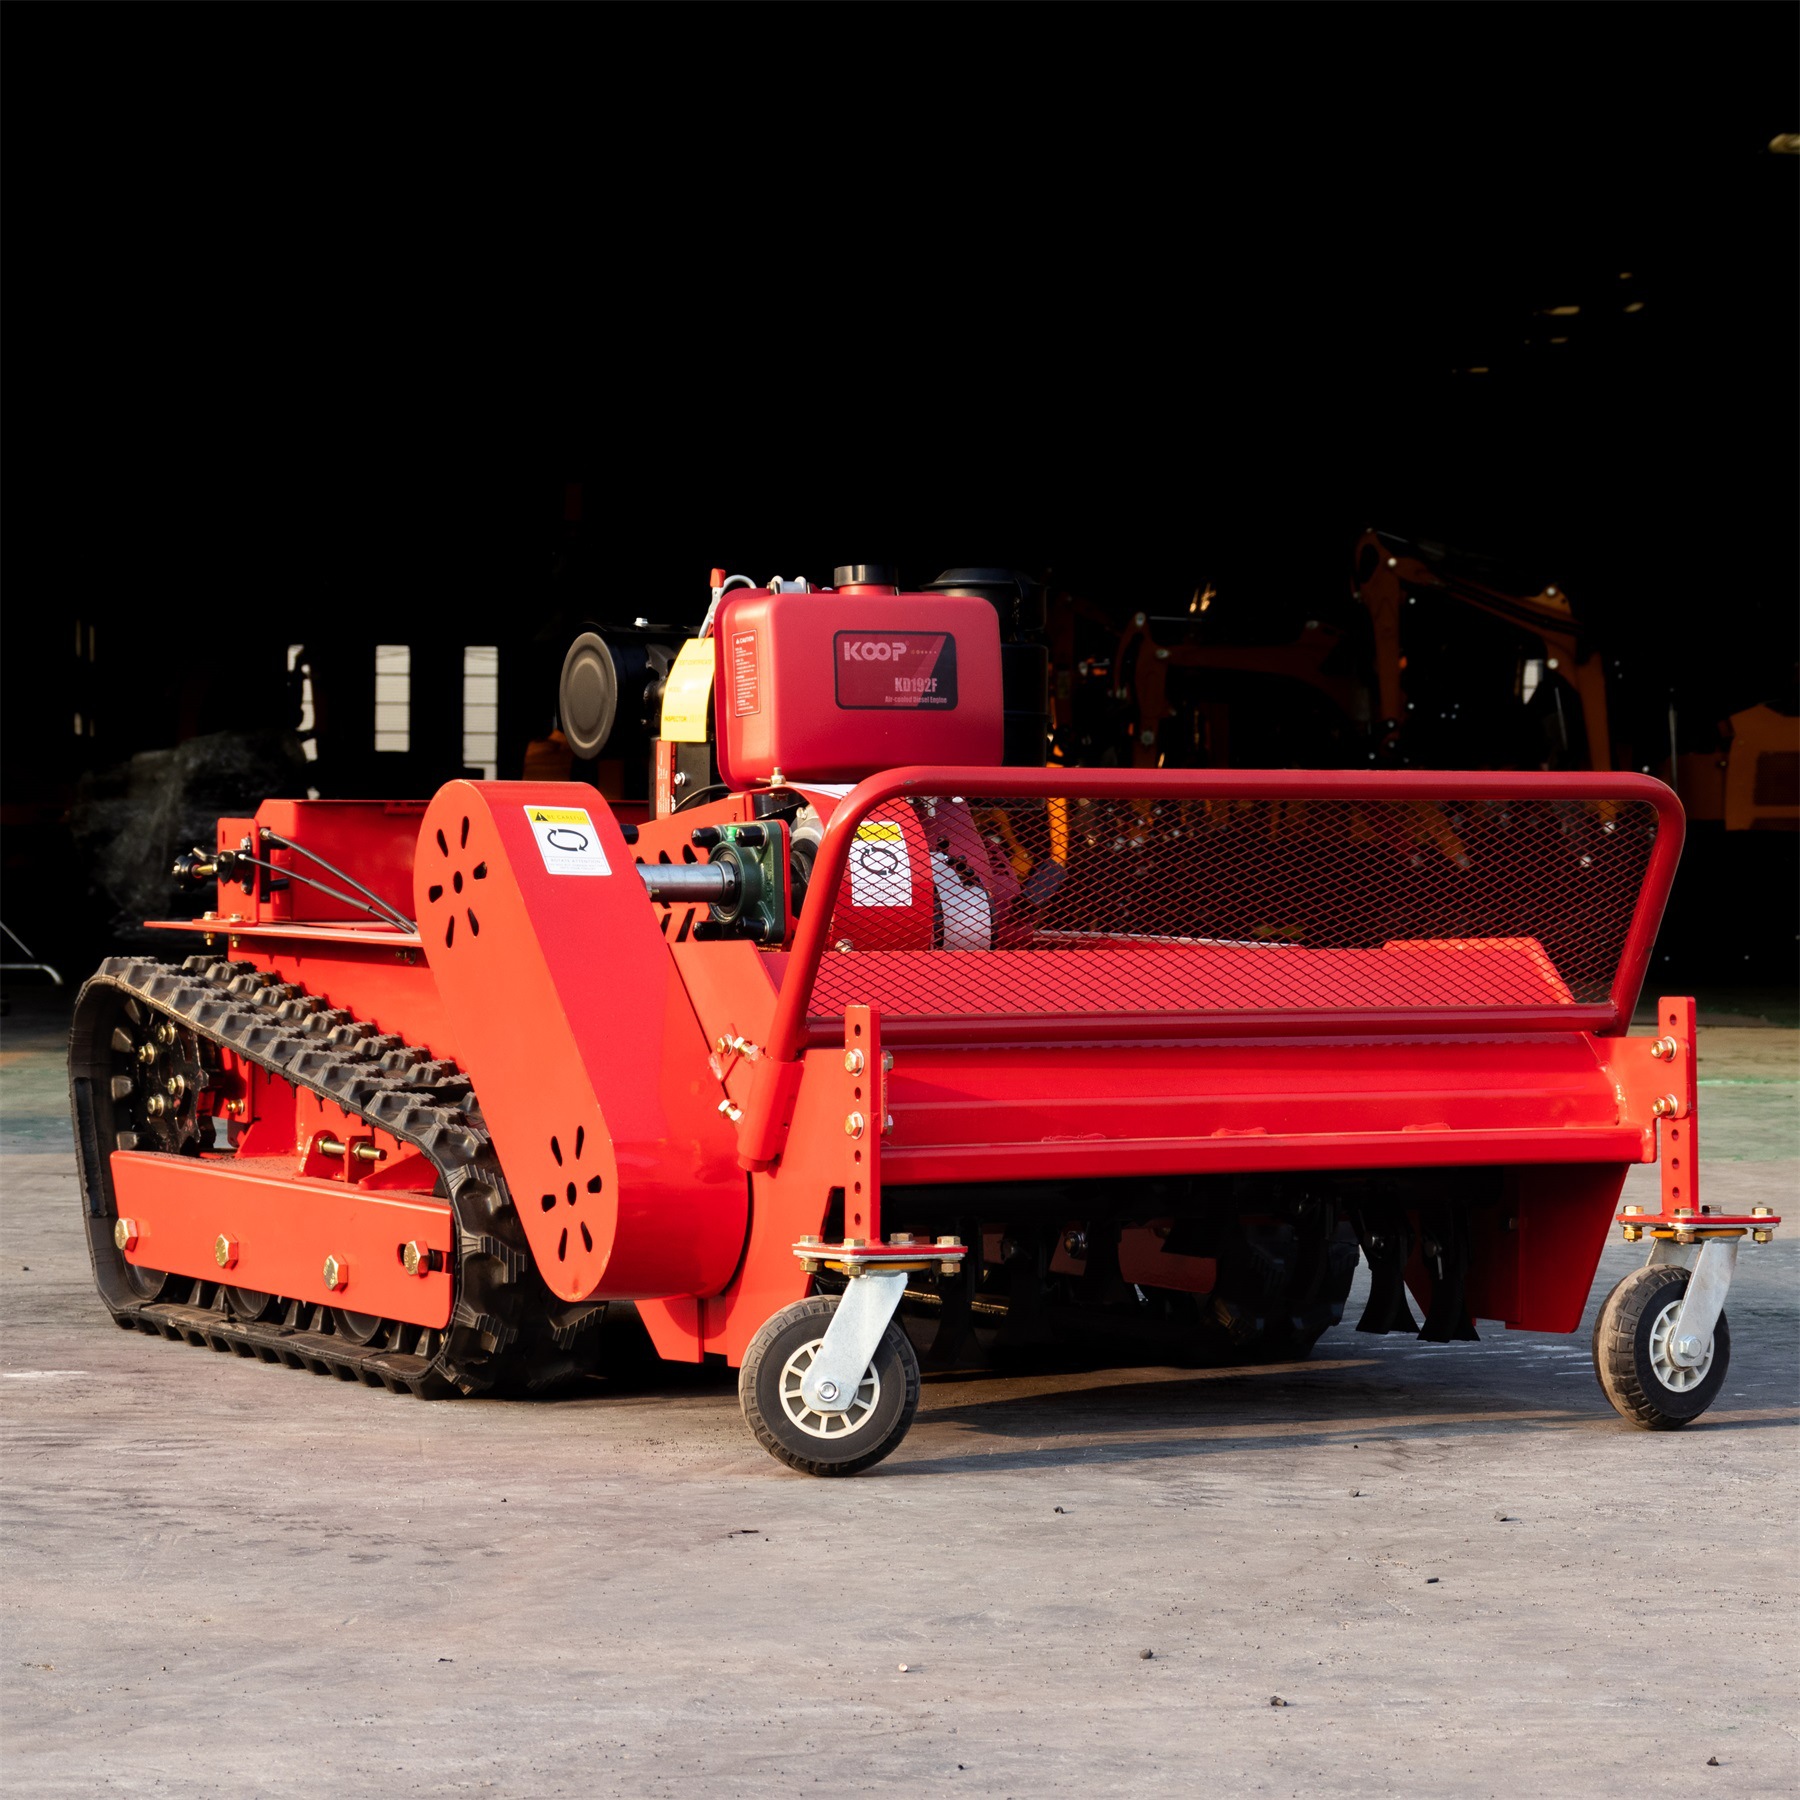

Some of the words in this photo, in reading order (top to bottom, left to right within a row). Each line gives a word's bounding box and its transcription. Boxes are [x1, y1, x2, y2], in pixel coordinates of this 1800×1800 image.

[844, 641, 907, 661] KOOP
[894, 677, 938, 692] KD192F
[930, 696, 948, 704] Engine
